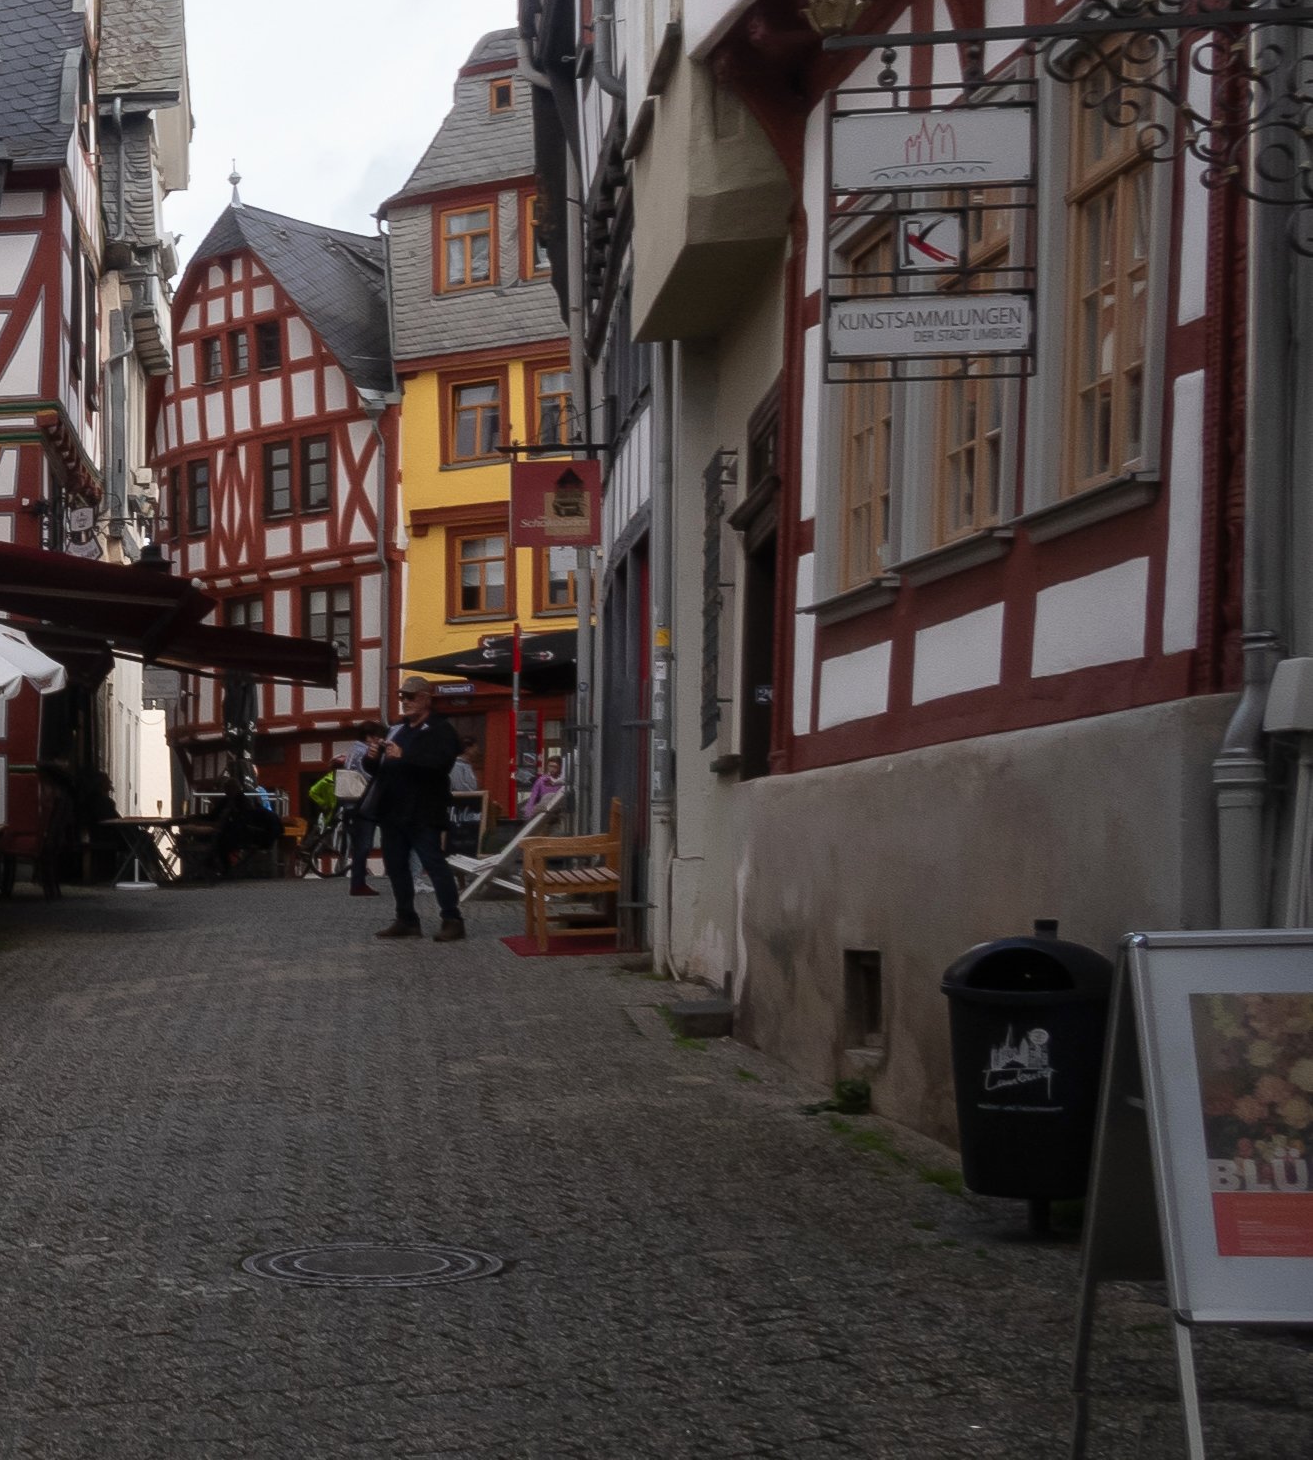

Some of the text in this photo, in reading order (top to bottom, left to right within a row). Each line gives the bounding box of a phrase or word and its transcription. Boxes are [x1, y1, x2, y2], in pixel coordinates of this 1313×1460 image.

[837, 306, 1022, 331] KUNSTSAMMLUNGEN
[913, 327, 1022, 343] DER STADT LIMBURG
